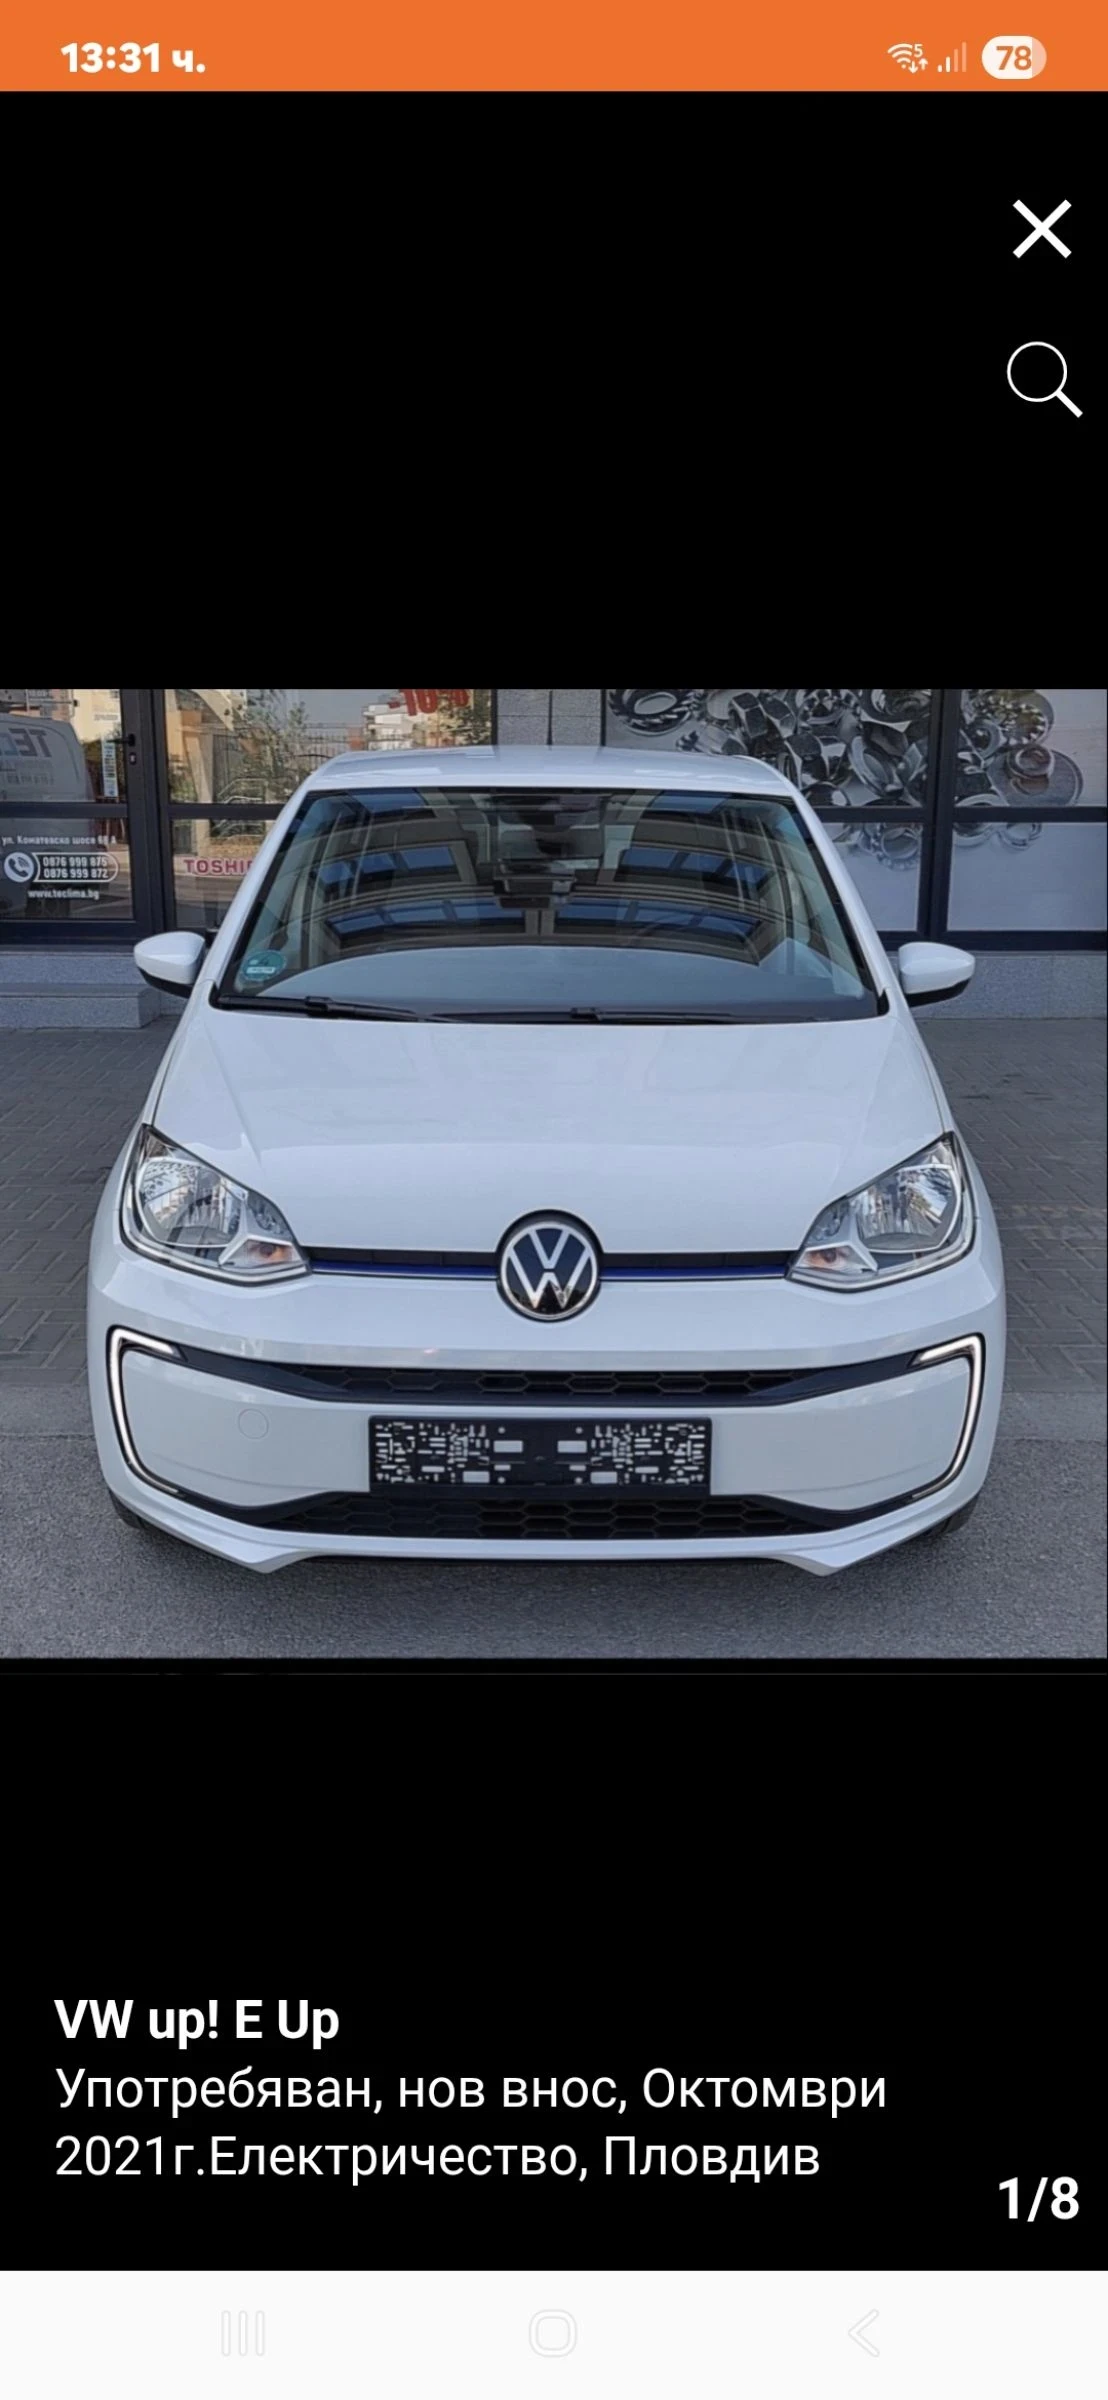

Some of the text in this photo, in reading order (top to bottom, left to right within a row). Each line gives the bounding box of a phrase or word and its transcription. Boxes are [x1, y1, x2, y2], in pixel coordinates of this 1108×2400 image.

[42, 856, 67, 867] 0876
[69, 856, 88, 867] 999
[43, 867, 109, 879] 0876 999 872
[27, 888, 100, 900] www.teclima.bg
[504, 1225, 593, 1309] VW
